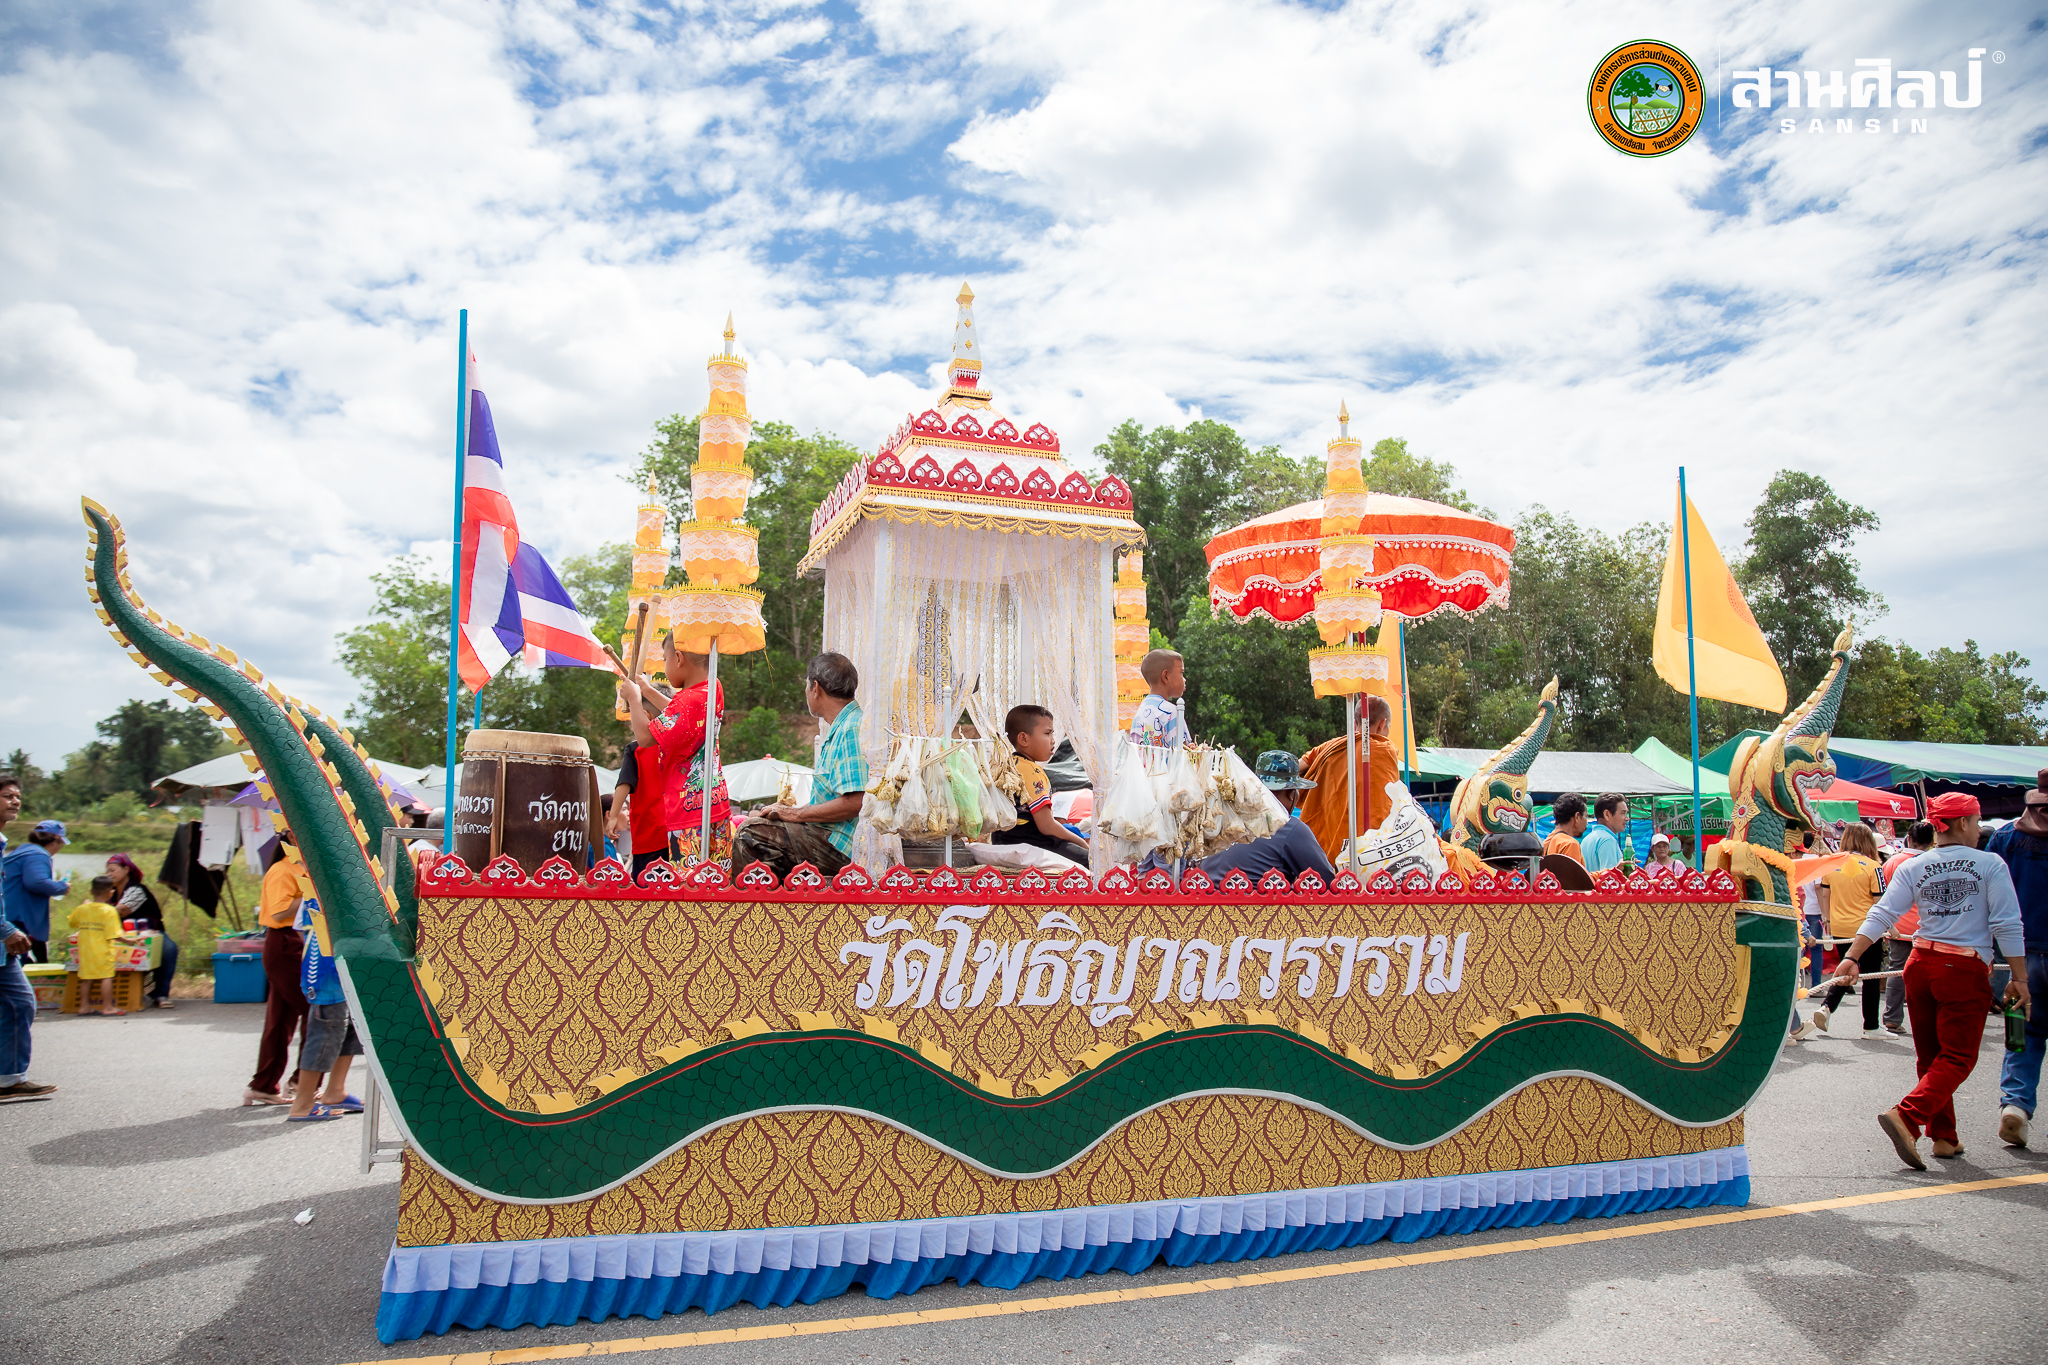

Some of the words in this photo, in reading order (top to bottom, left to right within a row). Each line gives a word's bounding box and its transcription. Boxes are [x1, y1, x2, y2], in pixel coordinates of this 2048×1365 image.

[1916, 866, 1982, 888] HARLEY-DAVIDSON
[1924, 860, 1976, 873] SMITH'S
[840, 904, 1470, 1028] วัดโพธิญาณวราราม
